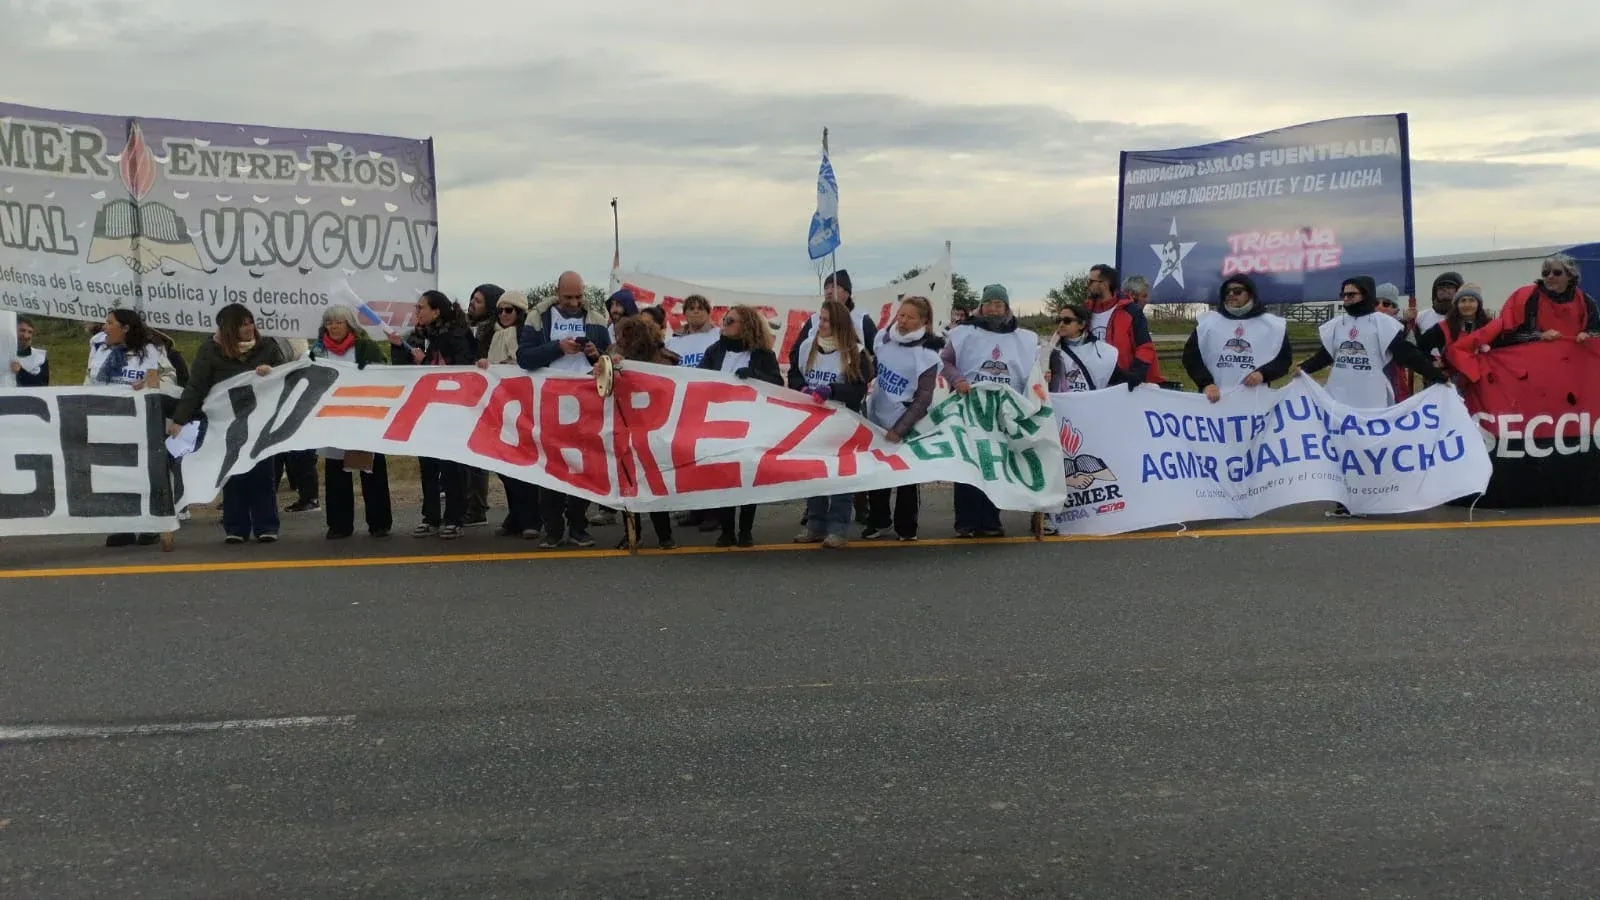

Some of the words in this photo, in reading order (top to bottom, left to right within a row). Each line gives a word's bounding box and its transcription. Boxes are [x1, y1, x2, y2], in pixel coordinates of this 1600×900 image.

[1197, 153, 1255, 176] CARLOS
[1260, 137, 1397, 168] FUENTEALBA
[1129, 195, 1145, 209] POR
[1146, 193, 1158, 208] UN
[1188, 178, 1285, 205] INDEPENDIENTE
[1290, 176, 1300, 193] Y
[1304, 174, 1326, 192] DE
[1329, 168, 1382, 190] LUCHA
[0, 201, 79, 255] NAL
[201, 207, 438, 273] URUGUAY
[1222, 247, 1341, 276] DOCENTE
[50, 273, 66, 290] de
[70, 274, 83, 292] la
[87, 280, 143, 297] escuela
[148, 281, 204, 301] pública
[209, 289, 218, 306] y
[224, 286, 247, 303] los
[253, 288, 329, 305] derechos
[3, 291, 18, 307] de
[20, 294, 40, 310] las
[43, 301, 51, 315] y
[54, 298, 76, 315] los
[79, 303, 170, 324] trabores
[176, 310, 193, 327] de
[200, 312, 212, 328] la
[1218, 355, 1254, 364] AGMER
[383, 370, 910, 497] POBREZA
[1472, 412, 1600, 458] SECCI
[1142, 451, 1220, 483] AGMER
[1064, 484, 1123, 508] GMER
[1361, 484, 1399, 494] escuela
